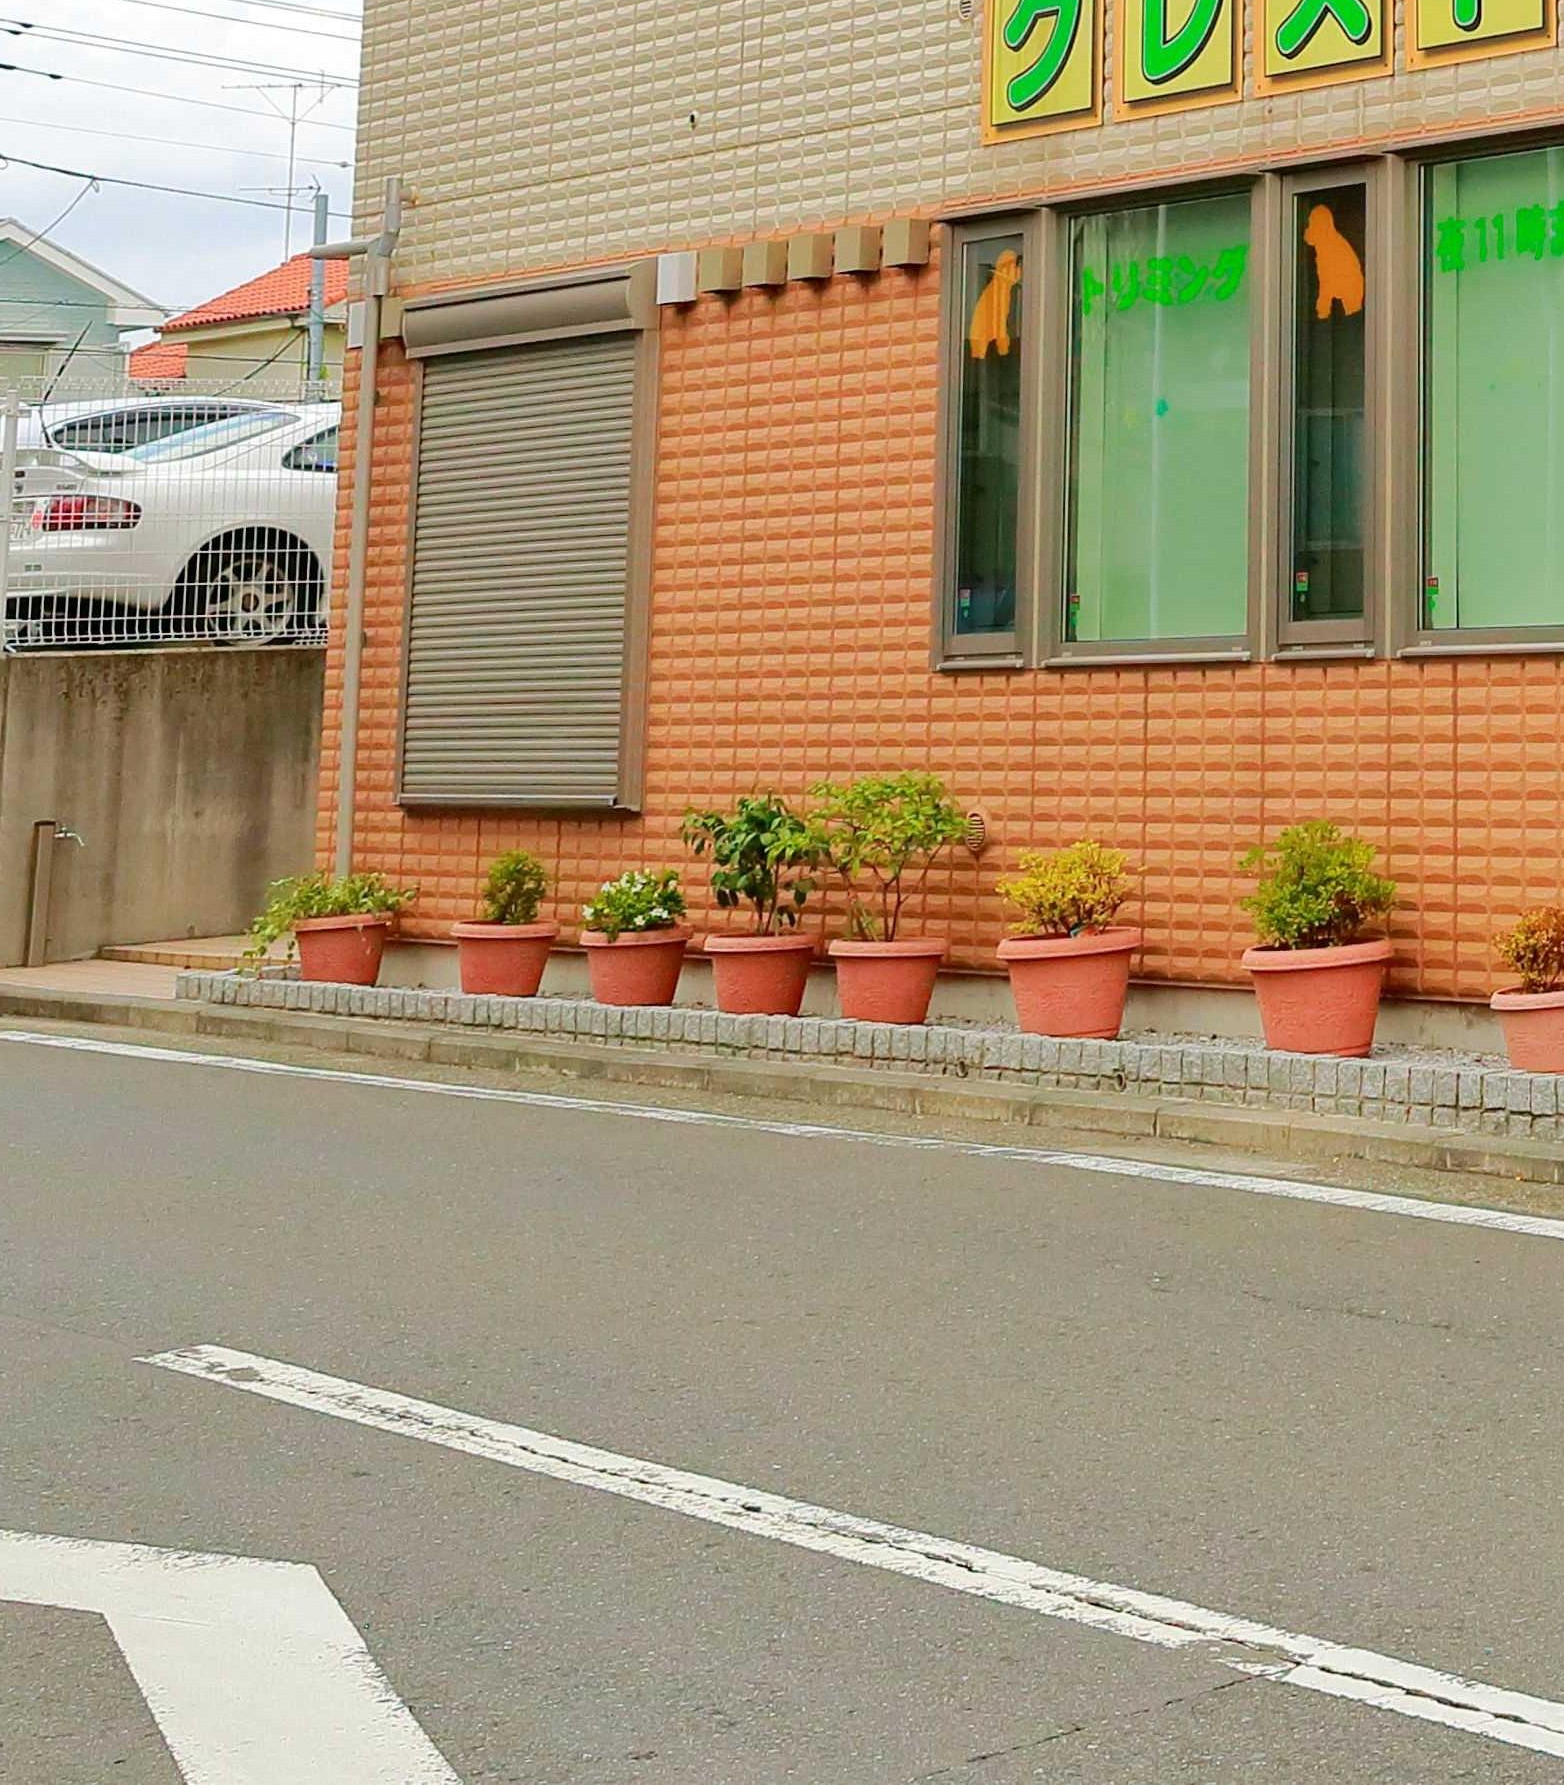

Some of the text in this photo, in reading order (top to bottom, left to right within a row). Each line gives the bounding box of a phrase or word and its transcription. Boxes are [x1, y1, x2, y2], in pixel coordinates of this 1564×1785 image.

[1083, 244, 1248, 317] トリミング
